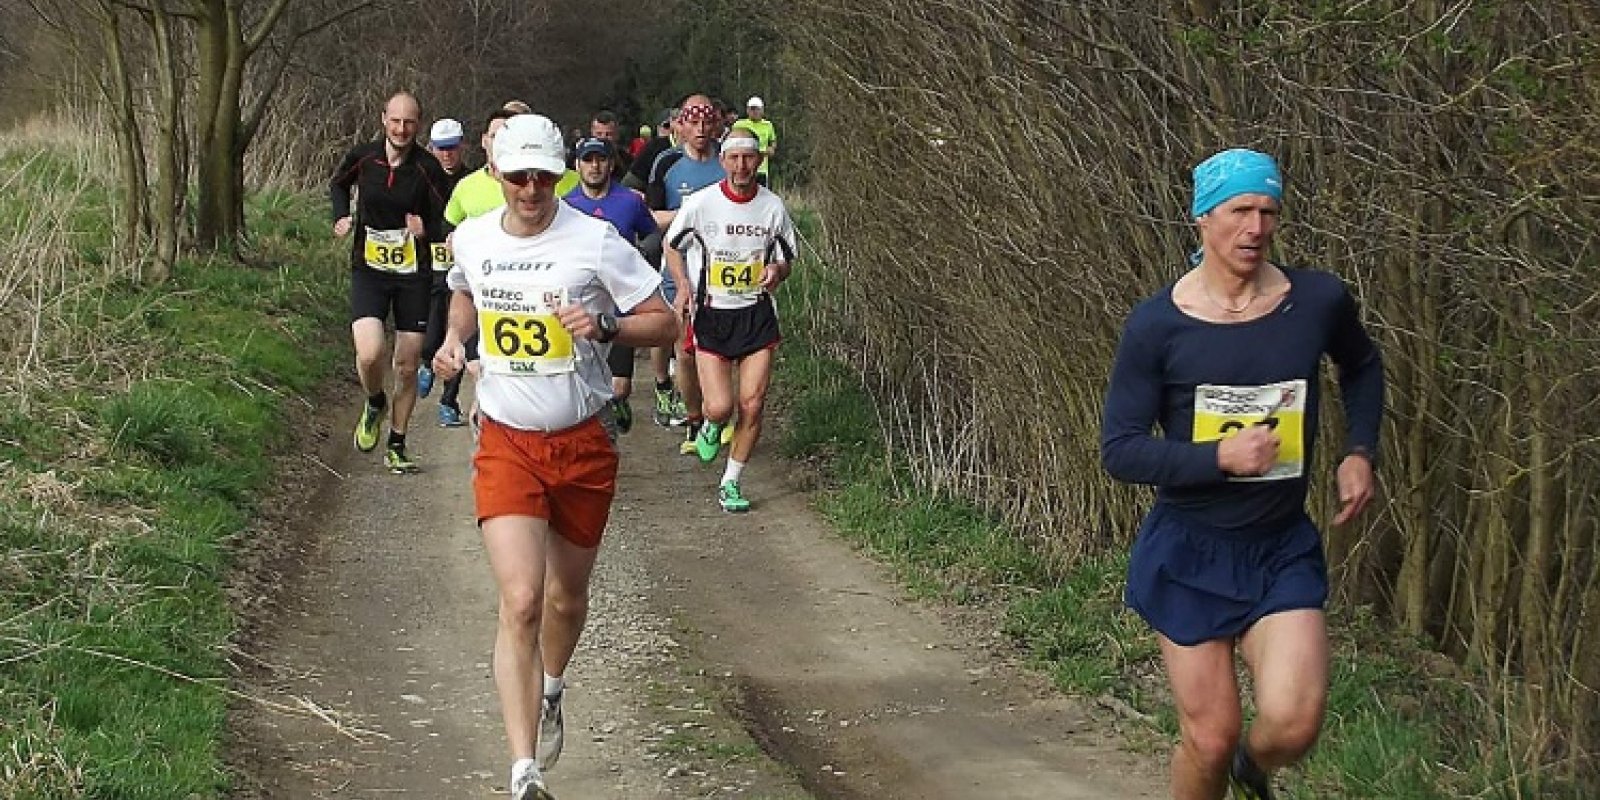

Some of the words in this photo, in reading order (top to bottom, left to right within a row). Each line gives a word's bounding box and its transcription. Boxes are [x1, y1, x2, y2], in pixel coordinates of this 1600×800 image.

[726, 225, 771, 237] BOSCH
[376, 246, 404, 265] 36
[494, 261, 556, 271] SCOTT
[721, 266, 752, 287] 64
[494, 317, 551, 356] 63
